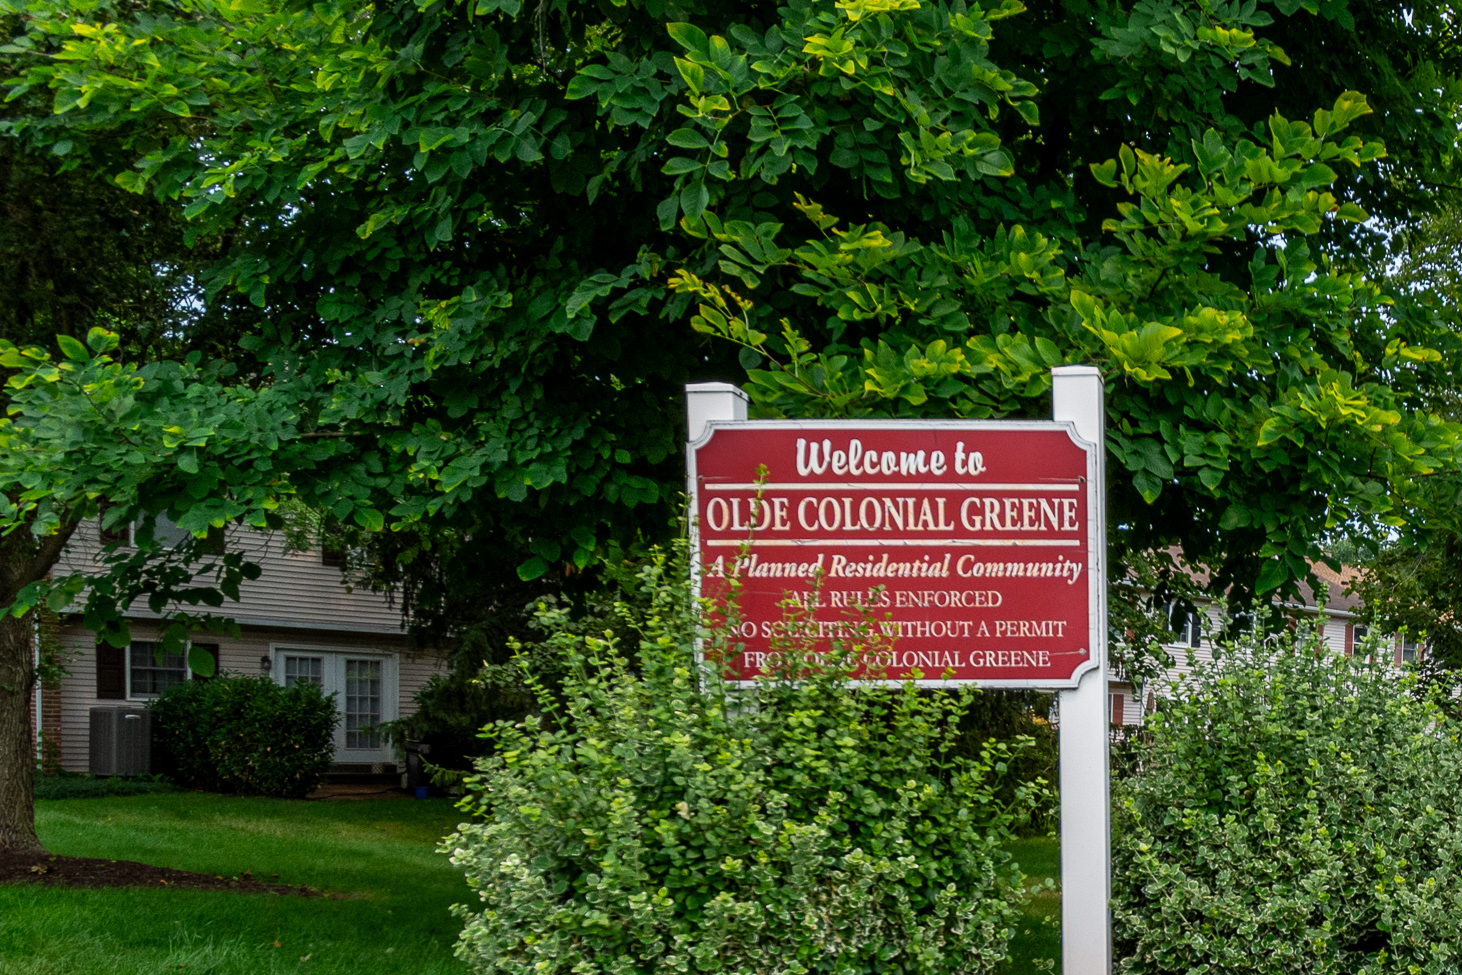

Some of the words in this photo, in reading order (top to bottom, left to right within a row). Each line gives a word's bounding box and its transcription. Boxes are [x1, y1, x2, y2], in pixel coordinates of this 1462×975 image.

[797, 438, 947, 477] Welcome
[954, 441, 987, 476] to
[706, 496, 791, 532] OLDE
[797, 496, 955, 532] COLONIAL
[961, 496, 1080, 532] GREENE
[706, 555, 726, 578] A
[732, 553, 825, 578] Planned
[828, 553, 952, 578] Residential
[956, 553, 1083, 585] Community
[829, 590, 890, 608] RULES
[894, 590, 1003, 608] ENFORCED
[878, 620, 973, 638] WITHOUT
[976, 620, 991, 638] A
[994, 620, 1067, 638] PERMIT
[743, 651, 801, 668] FRO
[969, 650, 1051, 668] GREENE
